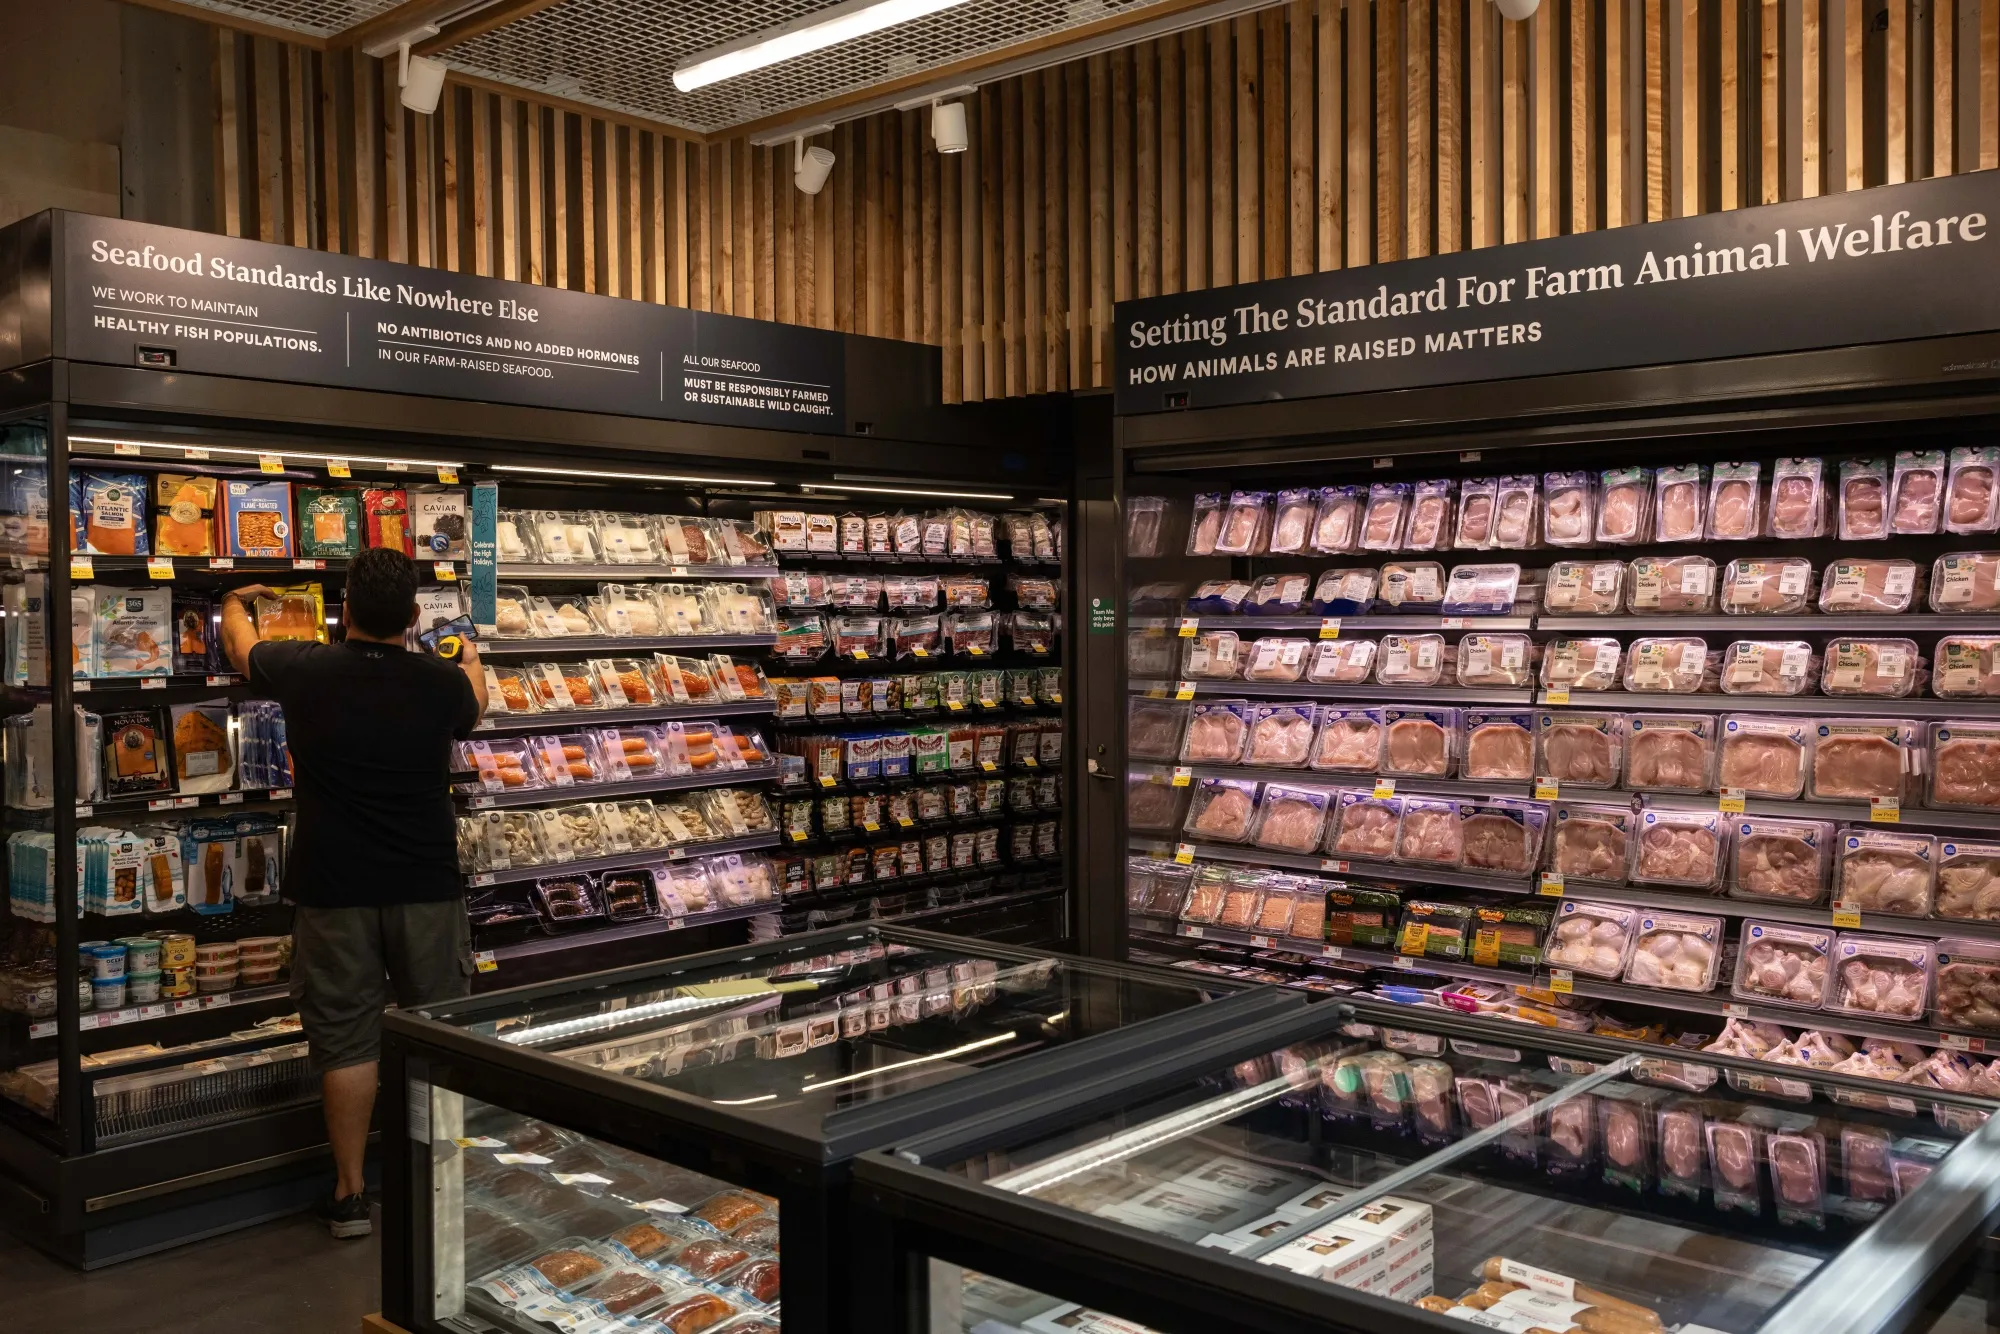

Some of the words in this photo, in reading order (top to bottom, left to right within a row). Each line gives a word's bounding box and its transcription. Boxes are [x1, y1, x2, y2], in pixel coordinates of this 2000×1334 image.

[92, 240, 203, 276] Seafood
[210, 257, 337, 294] Standards
[343, 276, 391, 303] Like
[397, 285, 493, 317] Nowhere
[498, 300, 539, 323] Else
[1130, 315, 1226, 348] Setting
[1234, 303, 1288, 336] The
[1296, 279, 1446, 328] Standard
[1458, 276, 1514, 308] For
[1526, 263, 1624, 300] Farm
[1634, 230, 1788, 286] Animal
[1798, 210, 1986, 263] Welfare
[92, 286, 116, 300] WE
[120, 288, 164, 306] WORK
[168, 294, 188, 310] TO
[192, 296, 258, 318] MAINTAIN
[94, 316, 170, 336] HEALTHY
[175, 325, 208, 341] FISH
[214, 328, 322, 353] POPULATIONS.
[378, 322, 398, 336] NO
[401, 324, 483, 348] ANTIBIOTICS
[486, 334, 512, 350] AND
[514, 338, 532, 352] NO
[536, 340, 574, 357] ADDED
[577, 345, 640, 366] HORMONES
[378, 348, 392, 360] IN
[394, 349, 420, 364] OUR
[424, 352, 500, 373] FARM-RAISED
[502, 362, 554, 378] SEAFOOD.
[683, 354, 699, 365] ALL
[701, 356, 719, 368] OUR
[721, 357, 760, 372] SEAFOOD
[1130, 364, 1176, 384] HOW
[1183, 352, 1278, 378] ANIMALS
[1285, 346, 1326, 368] ARE
[1334, 337, 1415, 363] RAISED
[1425, 322, 1542, 354] MATTERS
[684, 378, 706, 391] MUST
[709, 380, 722, 392] BE
[726, 381, 790, 398] RESPONSIBLY
[792, 388, 828, 402] FARMED
[684, 392, 698, 403] OR
[701, 394, 764, 410] SUSTAINABLE
[766, 400, 792, 412] WILD
[794, 402, 834, 416] CAUGHT.
[474, 558, 494, 567] Holidays.
[482, 549, 492, 558] High
